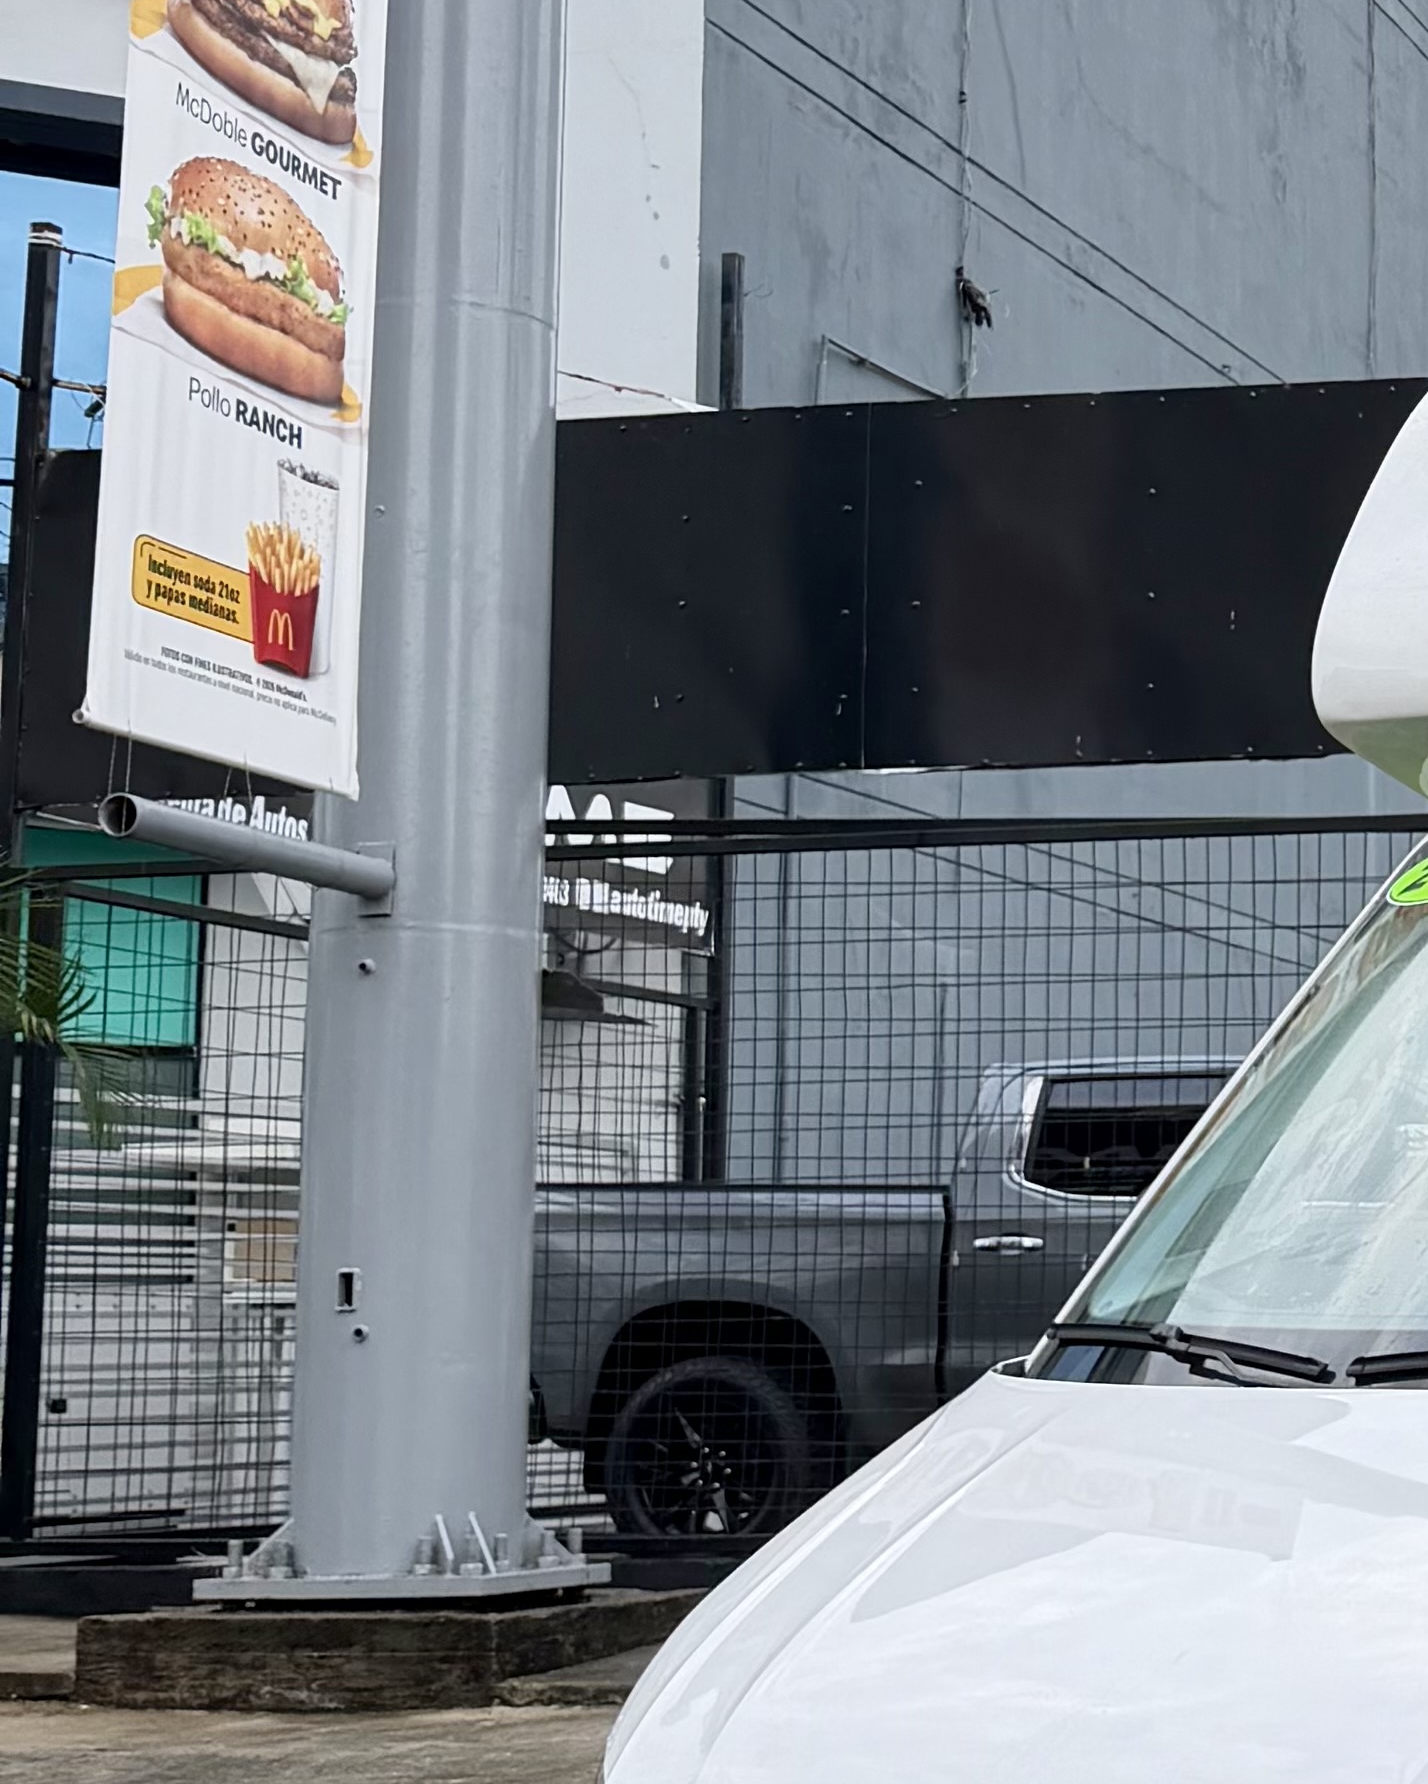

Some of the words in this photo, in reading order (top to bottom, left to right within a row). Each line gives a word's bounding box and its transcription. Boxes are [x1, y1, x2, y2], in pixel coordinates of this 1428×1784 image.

[176, 82, 248, 148] McDoble
[250, 131, 343, 201] GOURMET
[188, 376, 232, 418] Pollo
[235, 398, 304, 450] RANCH
[154, 582, 186, 607] papas
